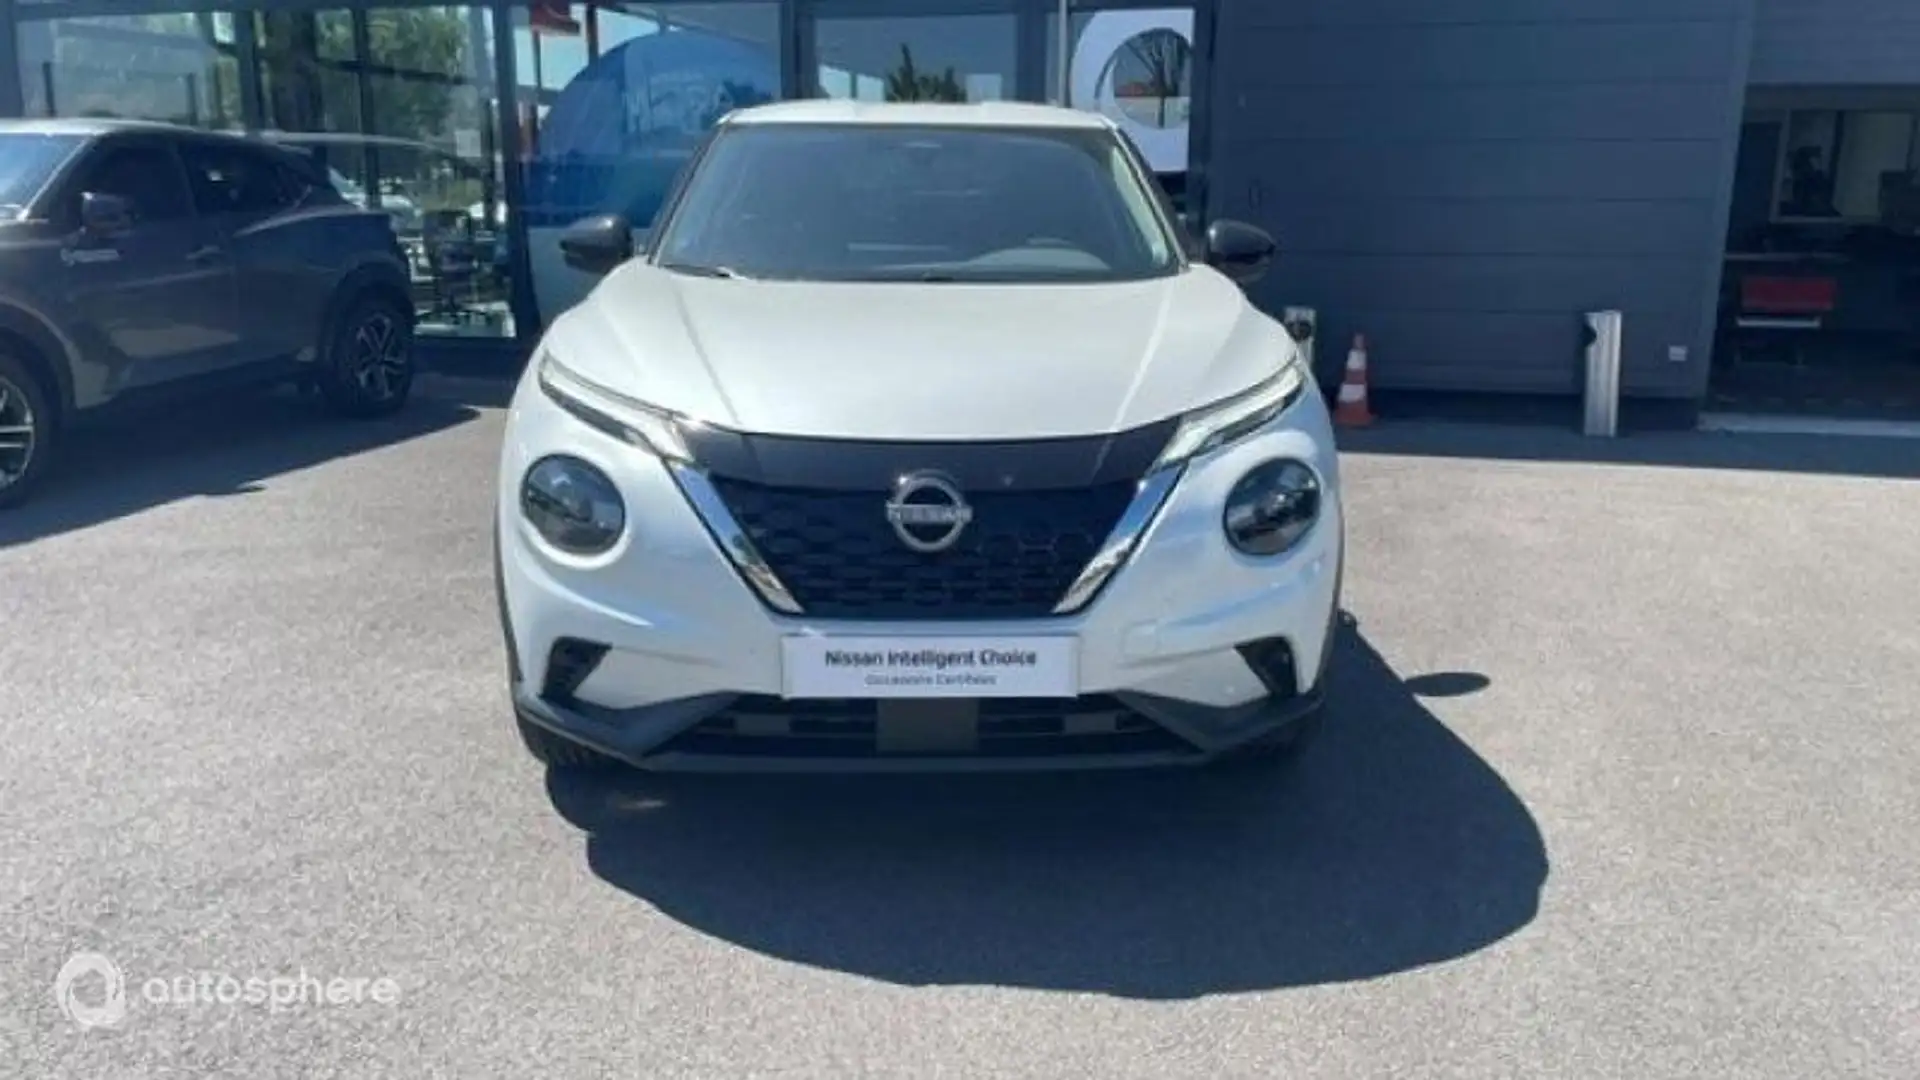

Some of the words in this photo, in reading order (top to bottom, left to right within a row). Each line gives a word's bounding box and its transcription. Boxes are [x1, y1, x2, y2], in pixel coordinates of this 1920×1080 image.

[825, 650, 882, 667] Nissan
[888, 650, 974, 670] Intelligent
[981, 649, 1036, 667] Choice
